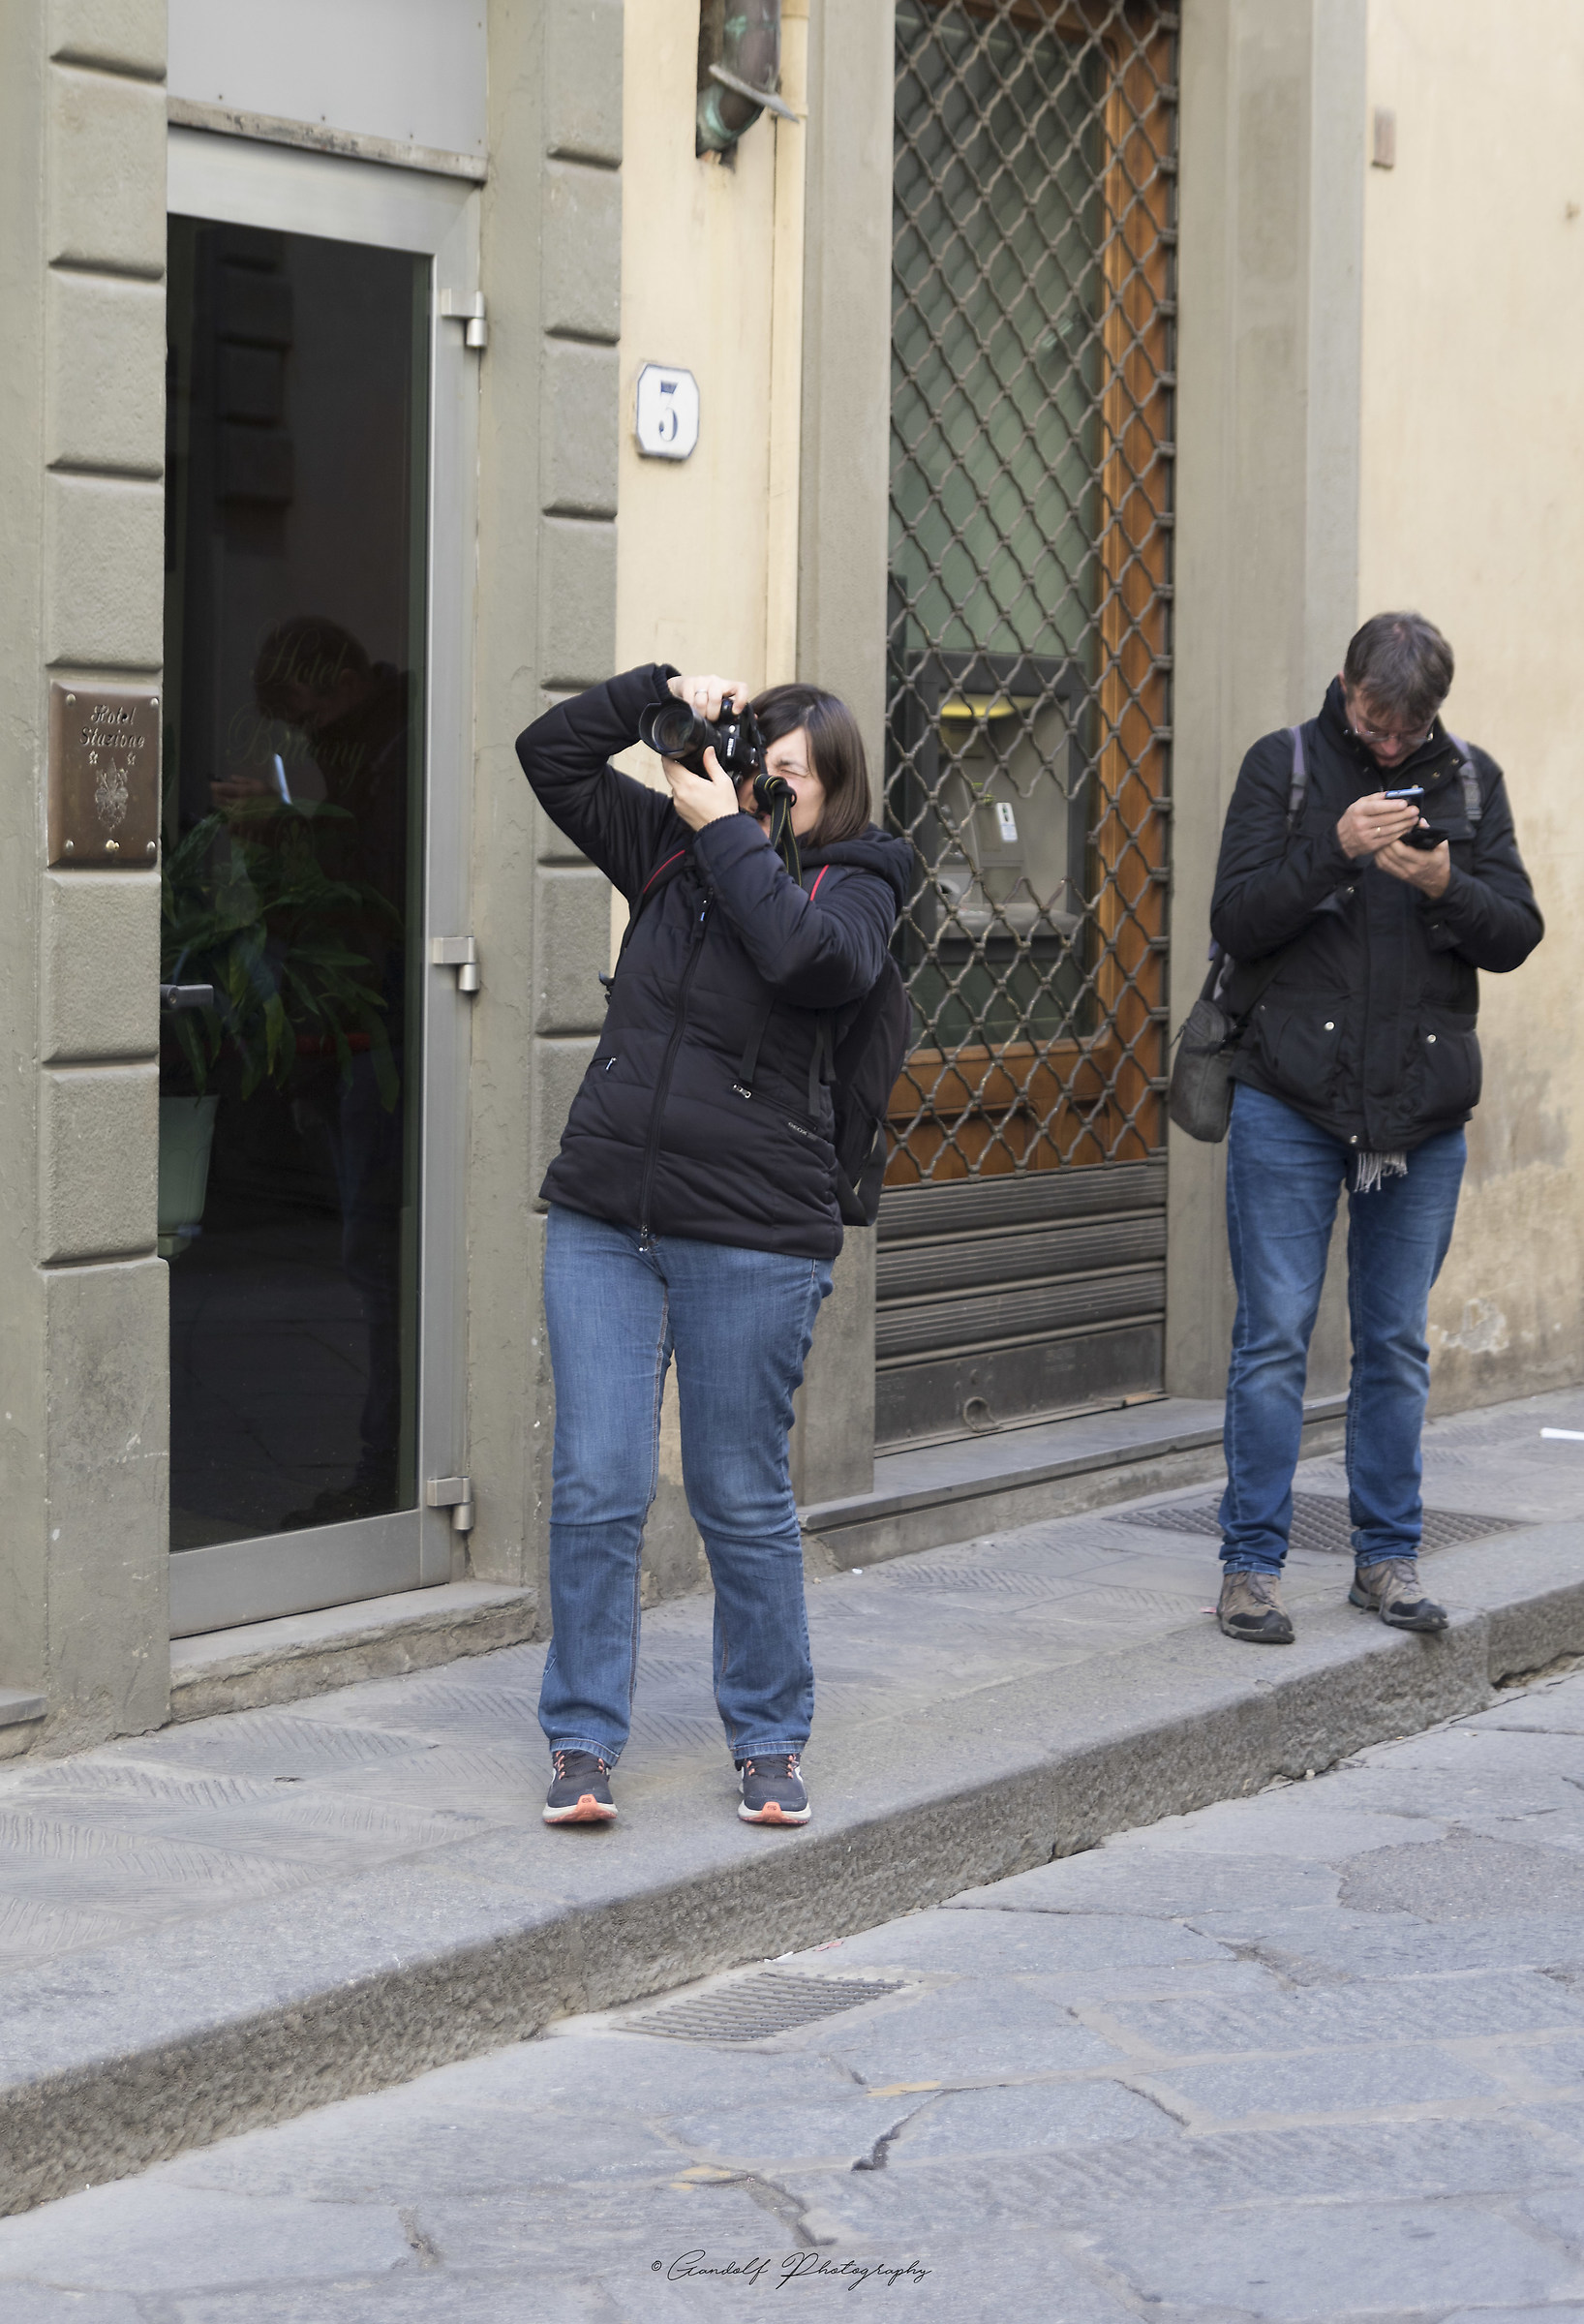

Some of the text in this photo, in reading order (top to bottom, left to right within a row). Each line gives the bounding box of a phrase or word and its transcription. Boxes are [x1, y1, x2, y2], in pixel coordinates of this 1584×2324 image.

[658, 380, 679, 443] 5
[249, 618, 350, 687] Hotel
[90, 705, 137, 724] Hotel
[79, 726, 145, 748] Stazione
